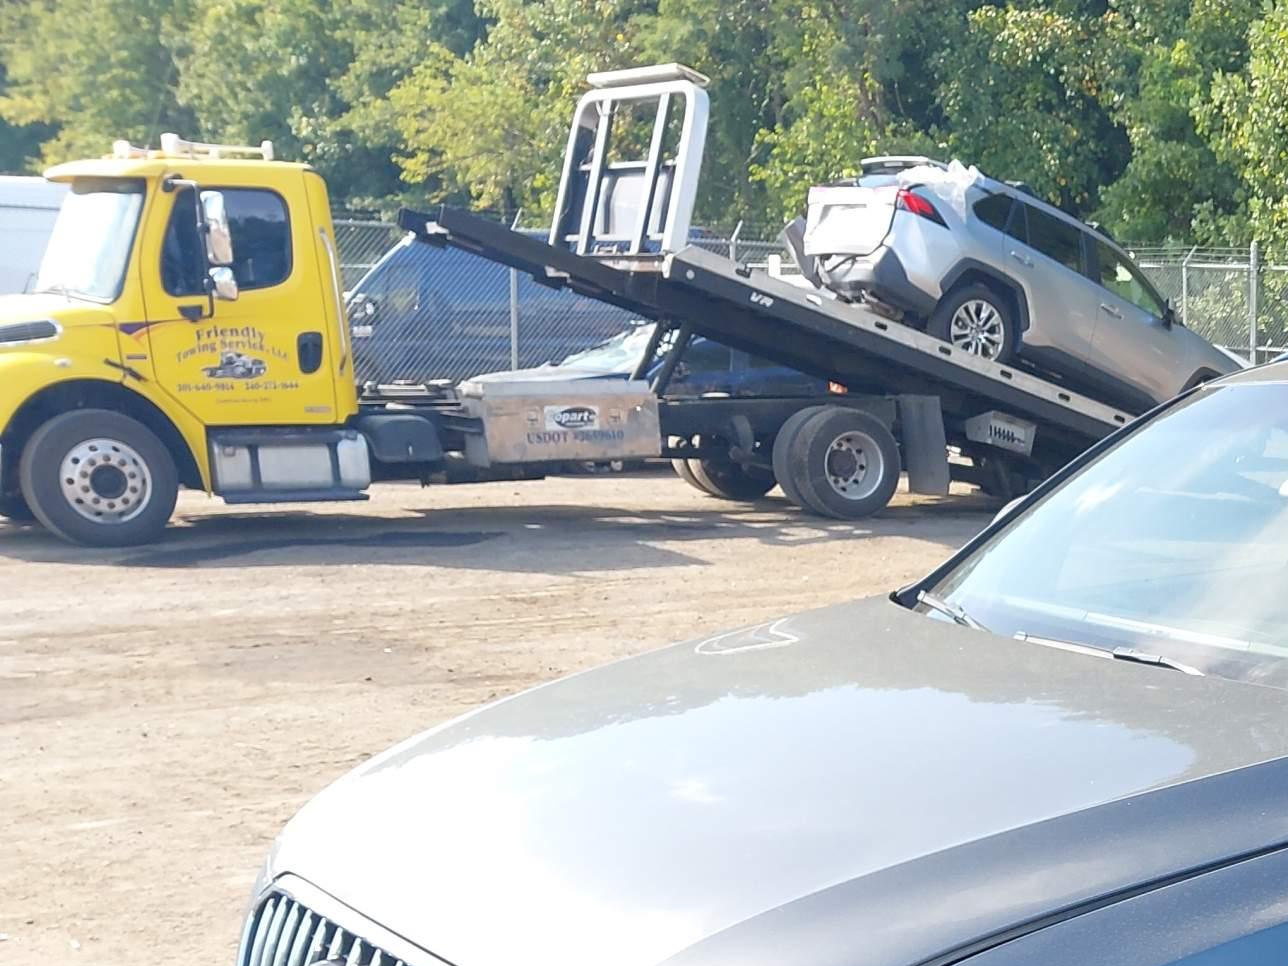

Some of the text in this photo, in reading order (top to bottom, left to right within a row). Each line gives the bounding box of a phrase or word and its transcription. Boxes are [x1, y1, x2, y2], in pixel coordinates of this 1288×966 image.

[196, 326, 264, 341] Friendly
[177, 341, 217, 362] Towing
[527, 431, 568, 444] USDOT
